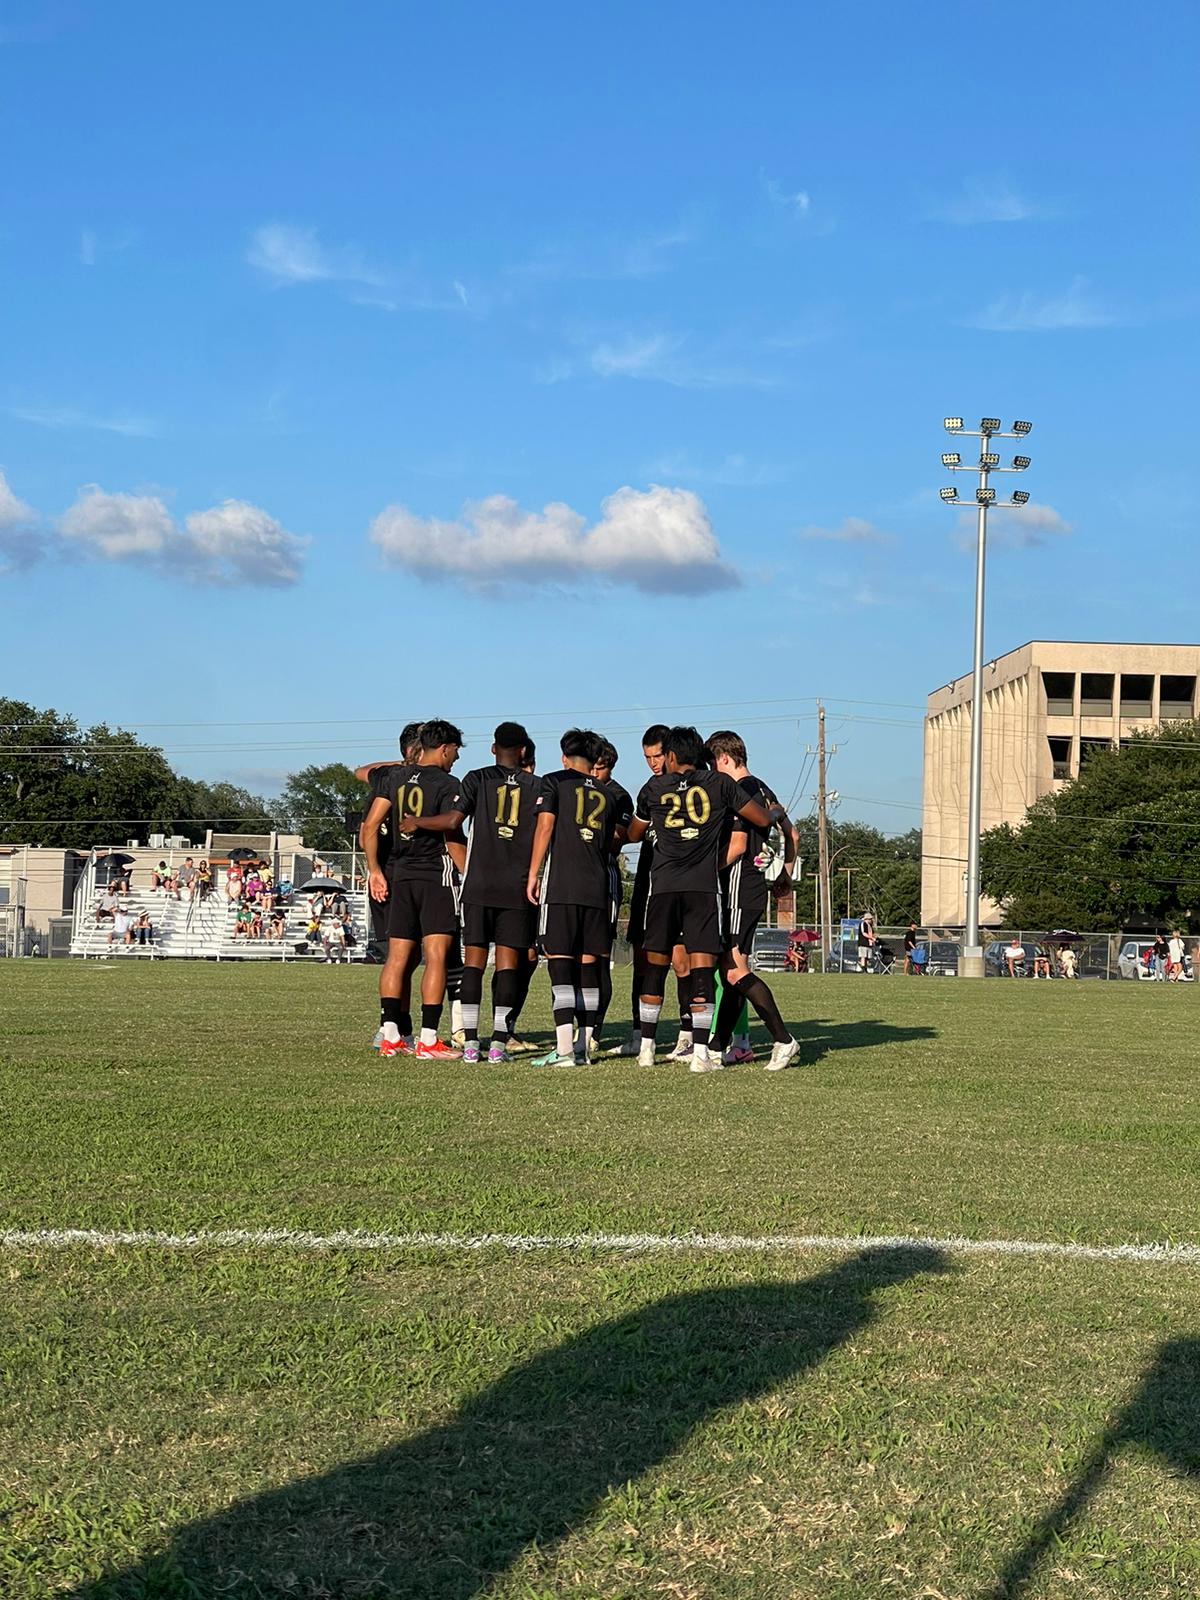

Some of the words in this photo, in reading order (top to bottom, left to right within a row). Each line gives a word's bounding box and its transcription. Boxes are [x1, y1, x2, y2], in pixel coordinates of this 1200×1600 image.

[397, 784, 424, 823] 19
[494, 784, 521, 827] 11
[575, 786, 607, 830] 12
[660, 785, 711, 828] 20
